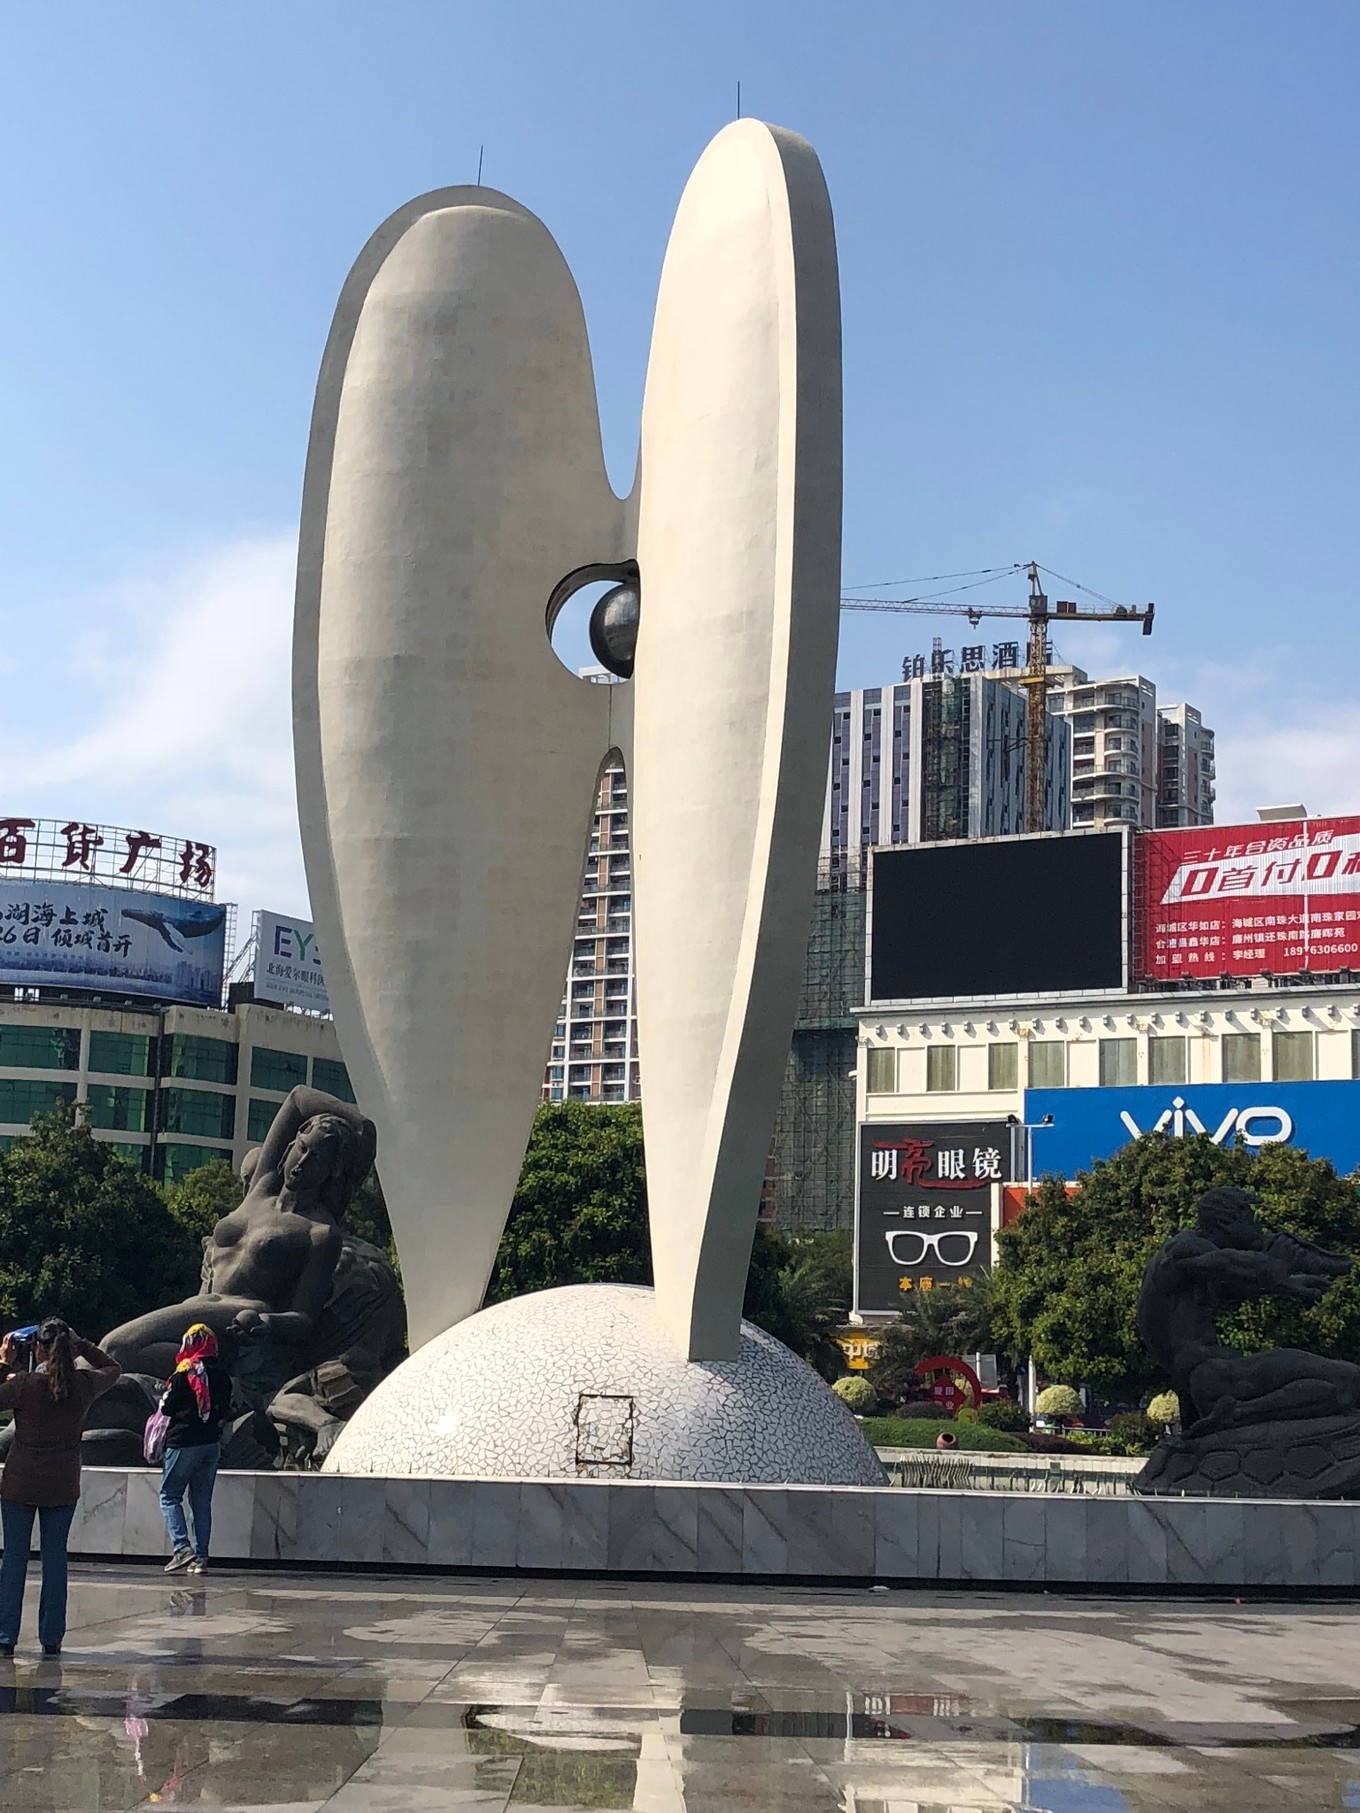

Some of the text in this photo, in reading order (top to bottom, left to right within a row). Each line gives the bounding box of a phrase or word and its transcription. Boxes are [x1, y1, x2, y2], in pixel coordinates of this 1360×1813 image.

[0, 818, 212, 888] 百货广场
[0, 901, 109, 932] 湖海上城
[1120, 1096, 1292, 1147] vivo
[871, 1136, 1003, 1190] 明亮眼镜
[902, 1205, 964, 1219] 连锁企业
